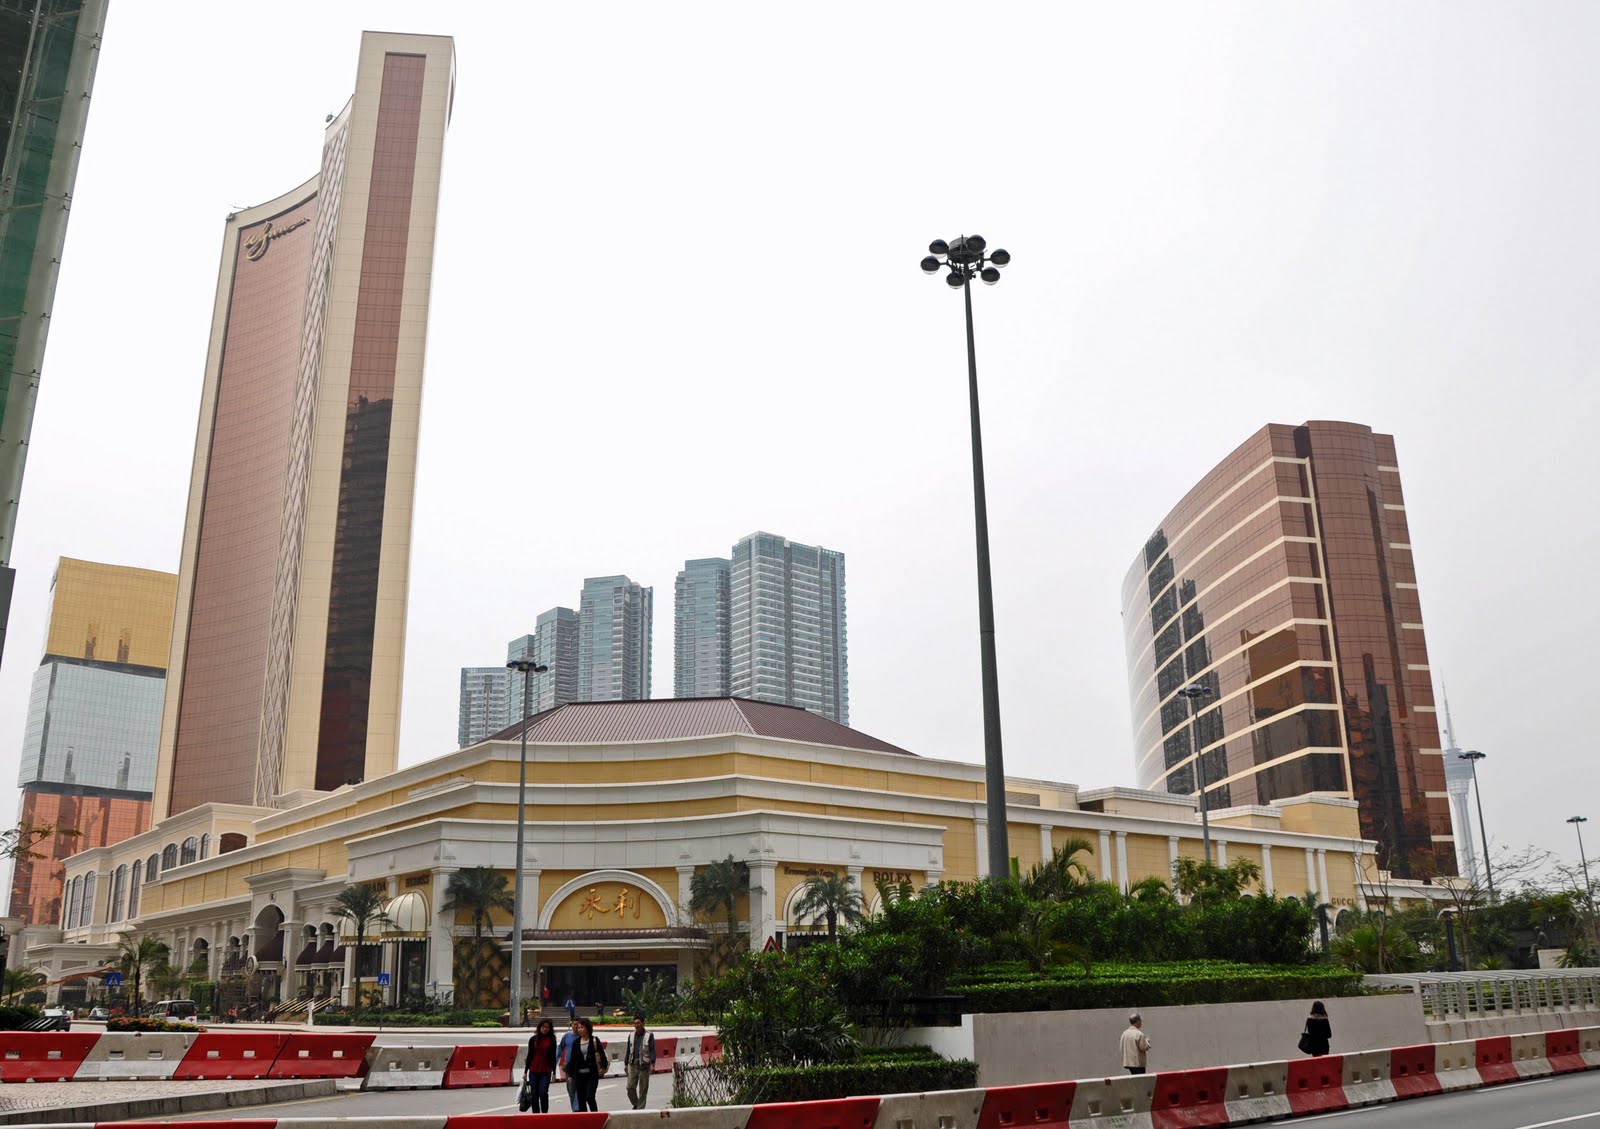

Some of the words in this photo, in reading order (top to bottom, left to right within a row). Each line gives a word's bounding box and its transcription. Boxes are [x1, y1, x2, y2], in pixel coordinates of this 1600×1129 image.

[873, 871, 912, 884] ROLEX
[579, 888, 642, 920] 永利
[1331, 897, 1354, 906] GUCCI
